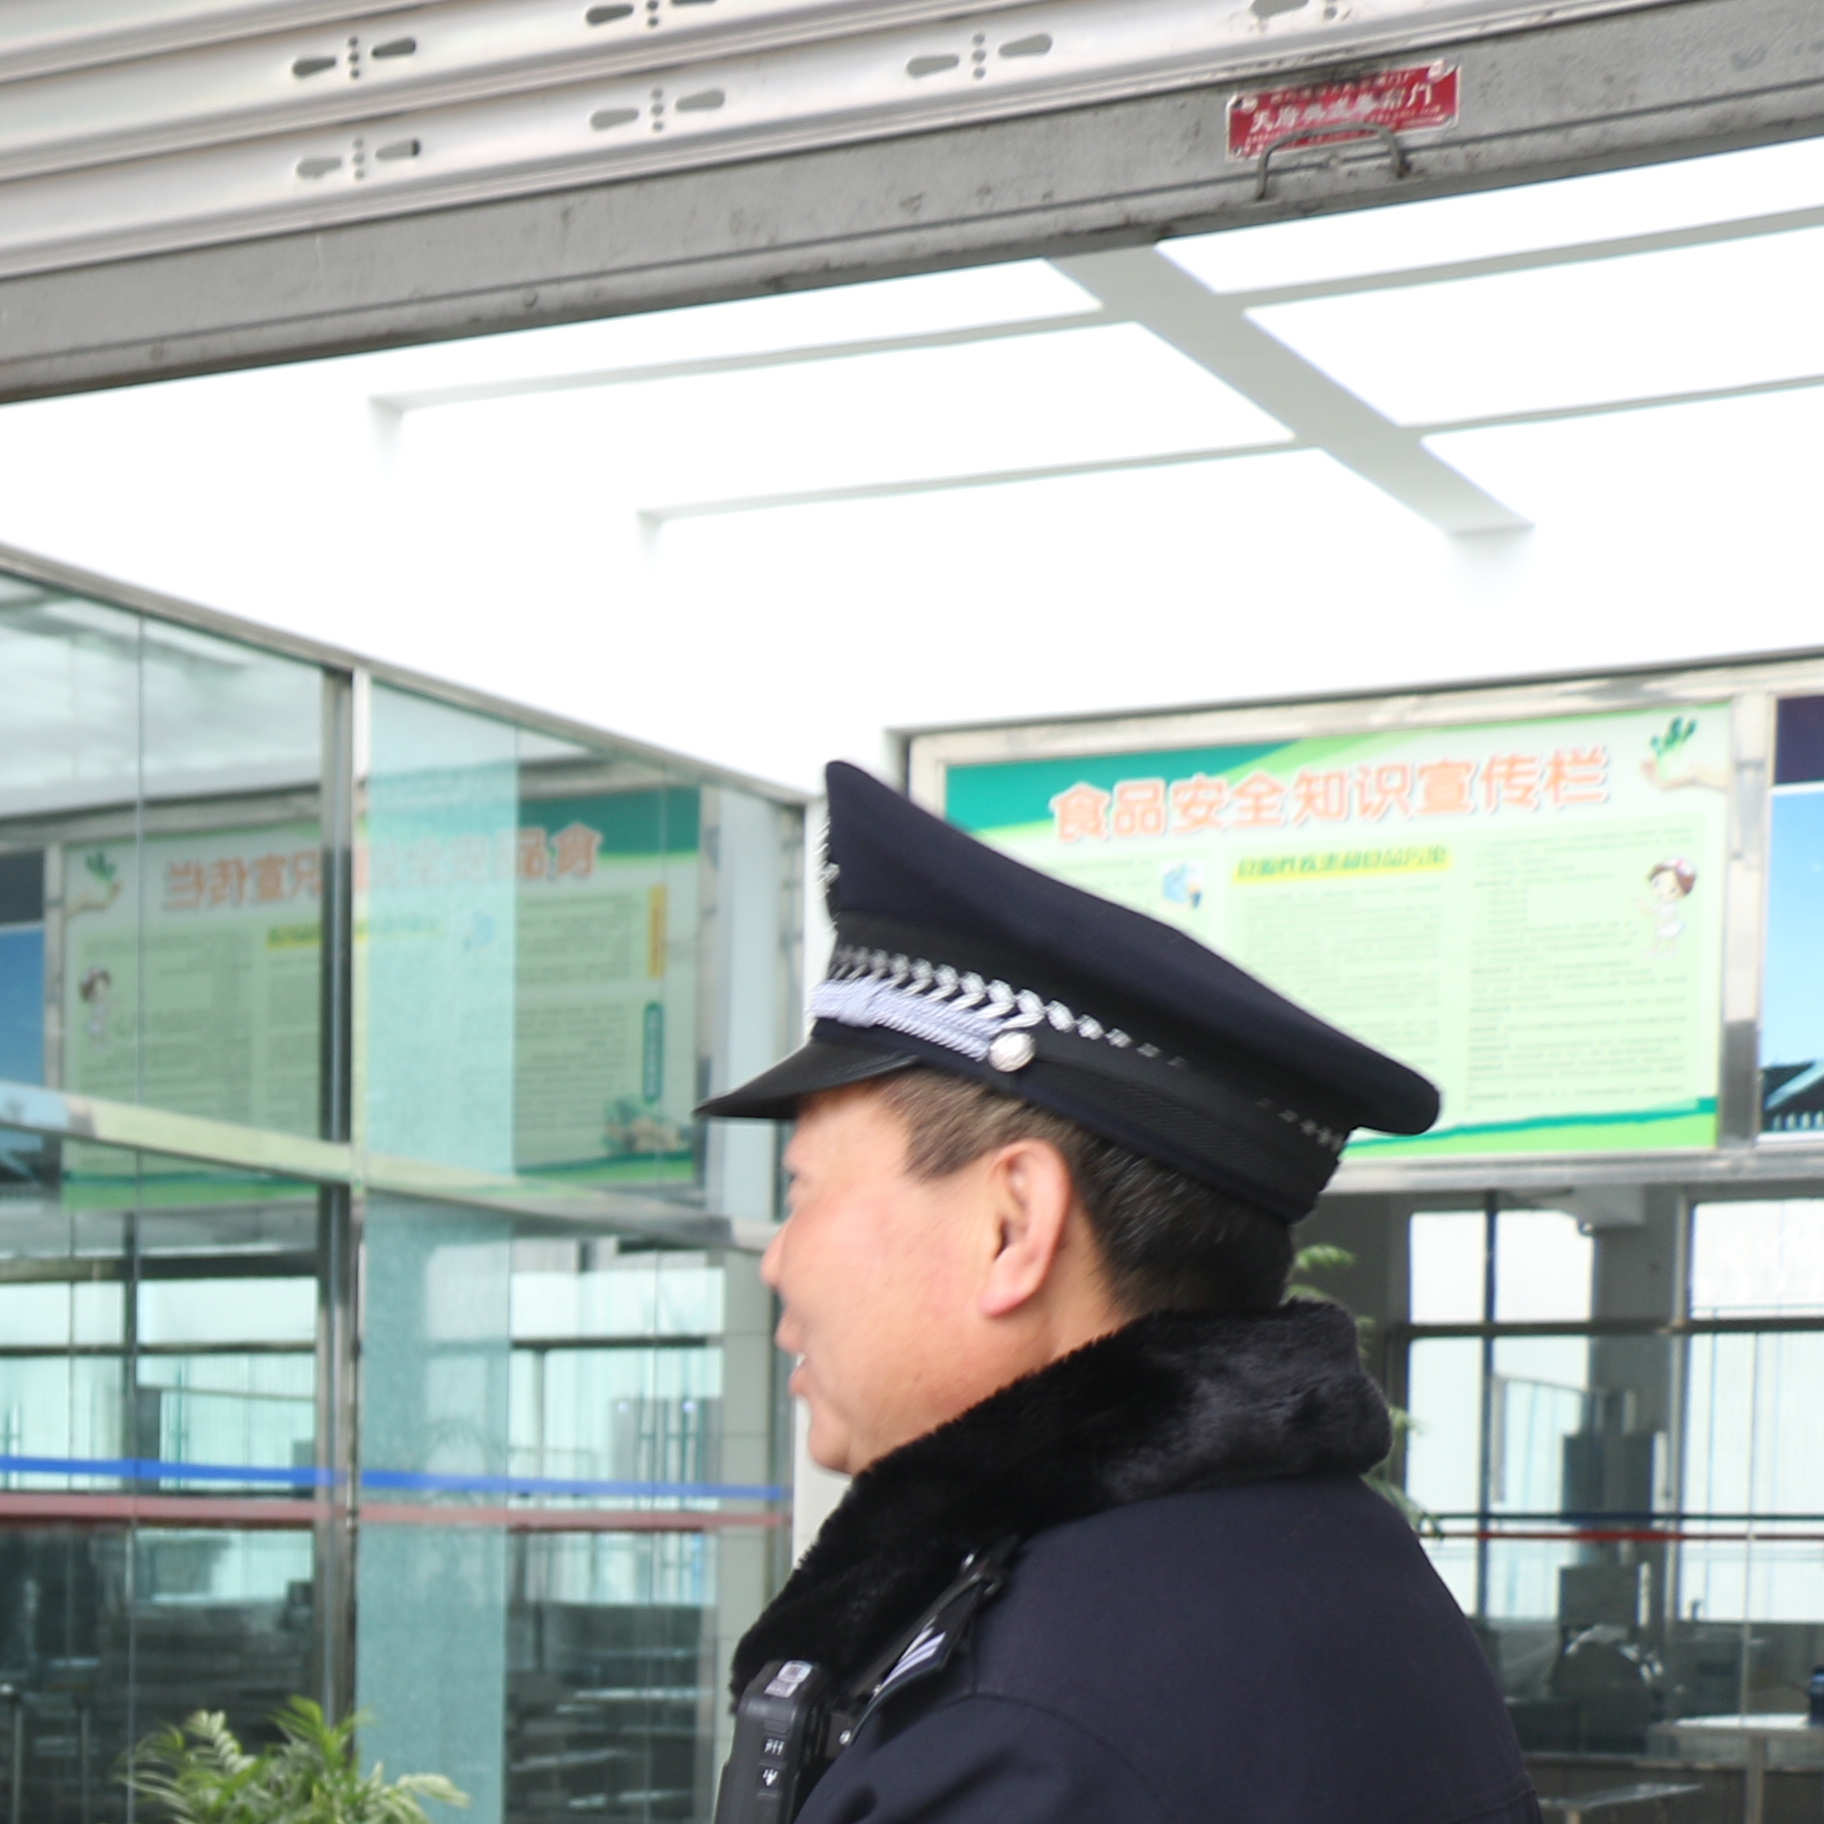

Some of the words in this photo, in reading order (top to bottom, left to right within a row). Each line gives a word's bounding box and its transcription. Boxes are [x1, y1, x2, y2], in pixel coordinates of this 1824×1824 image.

[1050, 746, 1608, 842] 食品安全知识宣传栏
